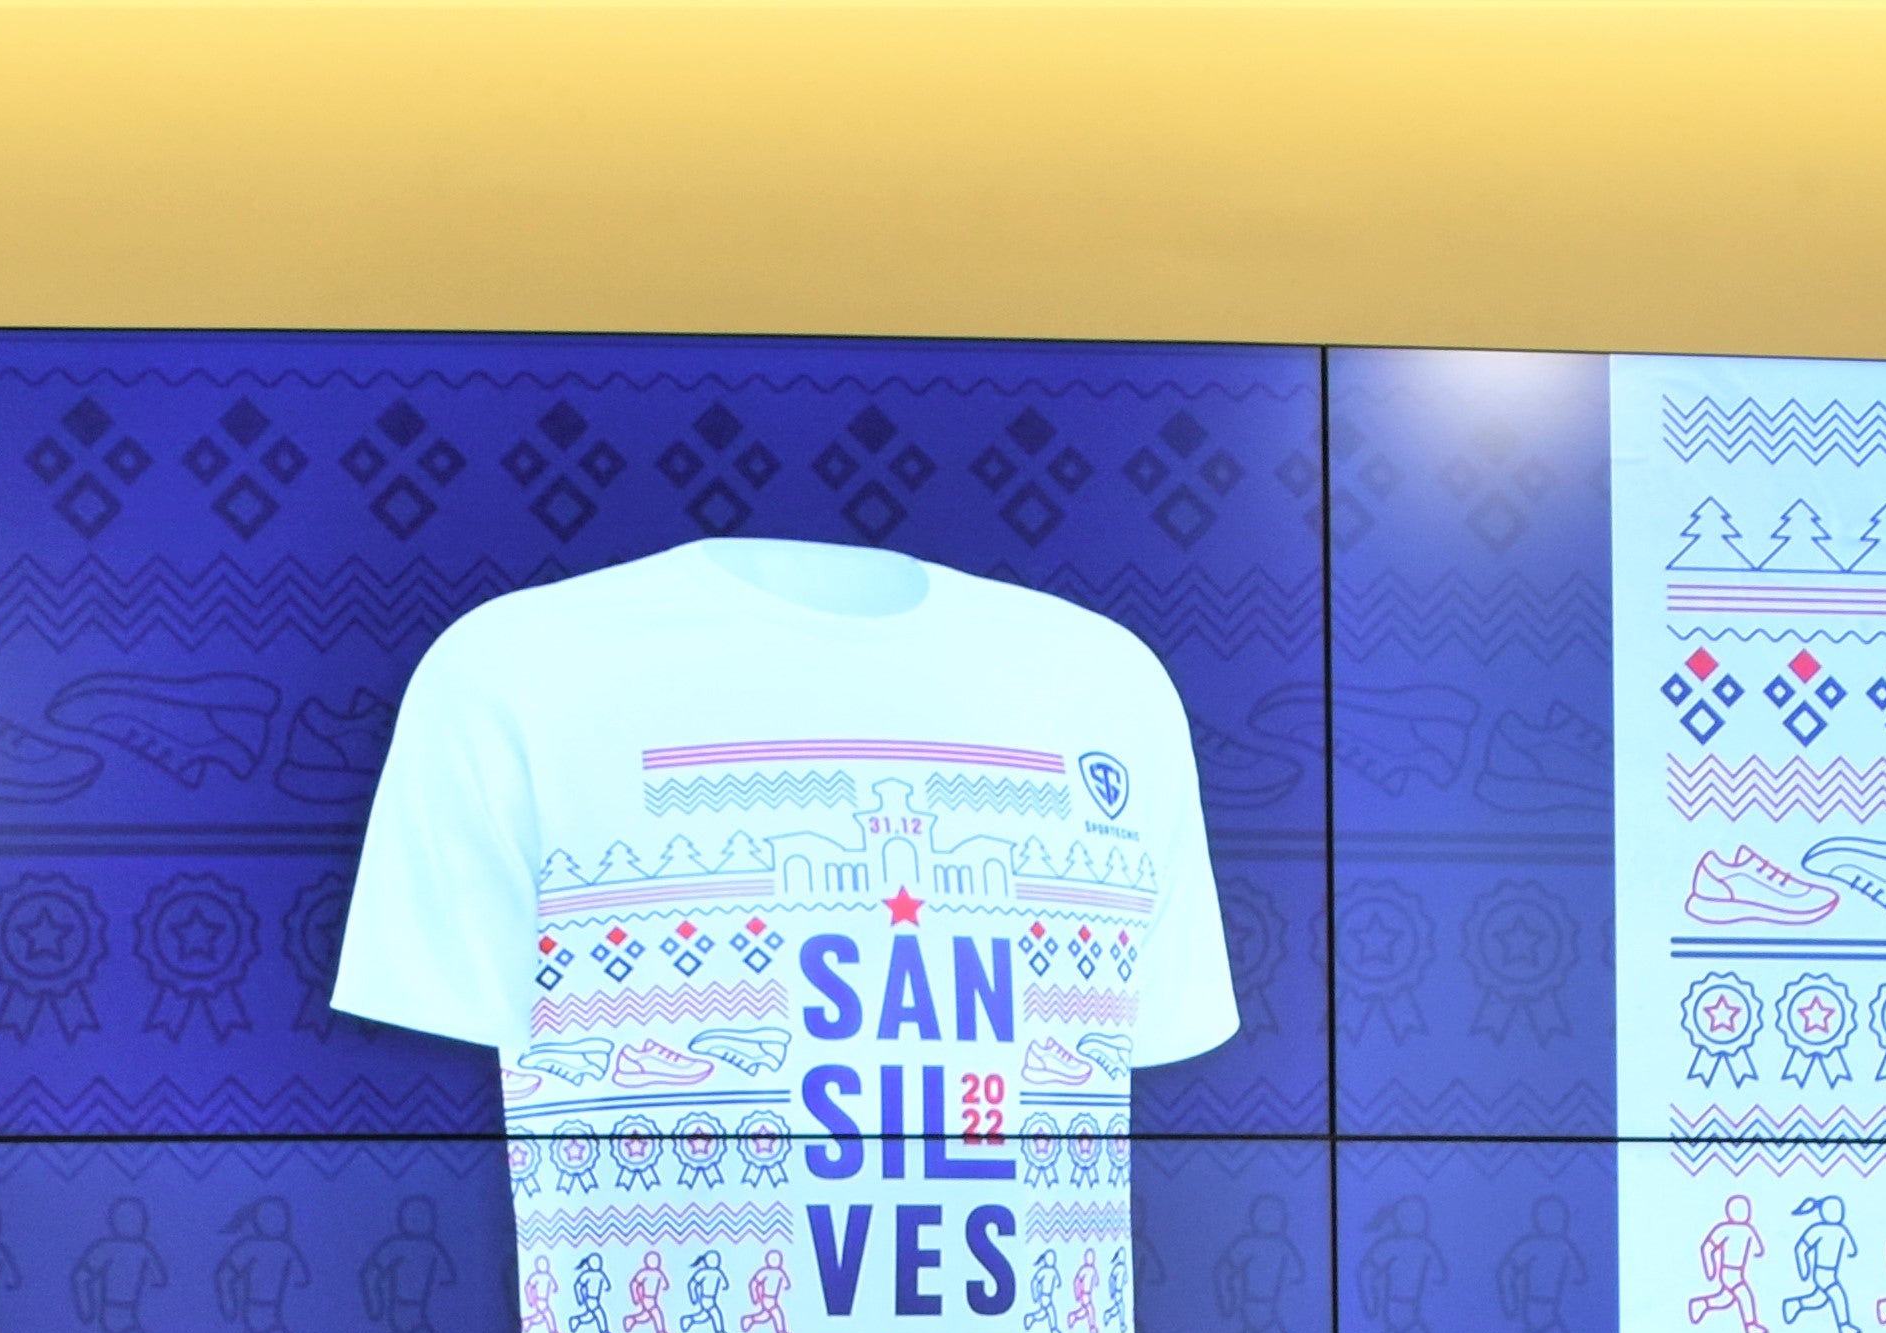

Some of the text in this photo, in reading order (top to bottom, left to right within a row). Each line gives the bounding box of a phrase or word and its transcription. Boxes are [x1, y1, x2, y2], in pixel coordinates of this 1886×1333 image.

[869, 815, 922, 834] 31.12
[799, 934, 1015, 1042] SAN
[801, 1064, 1016, 1180] SIL
[961, 1073, 1006, 1106] 20
[961, 1109, 1006, 1145] 22
[807, 1203, 1015, 1317] VES
